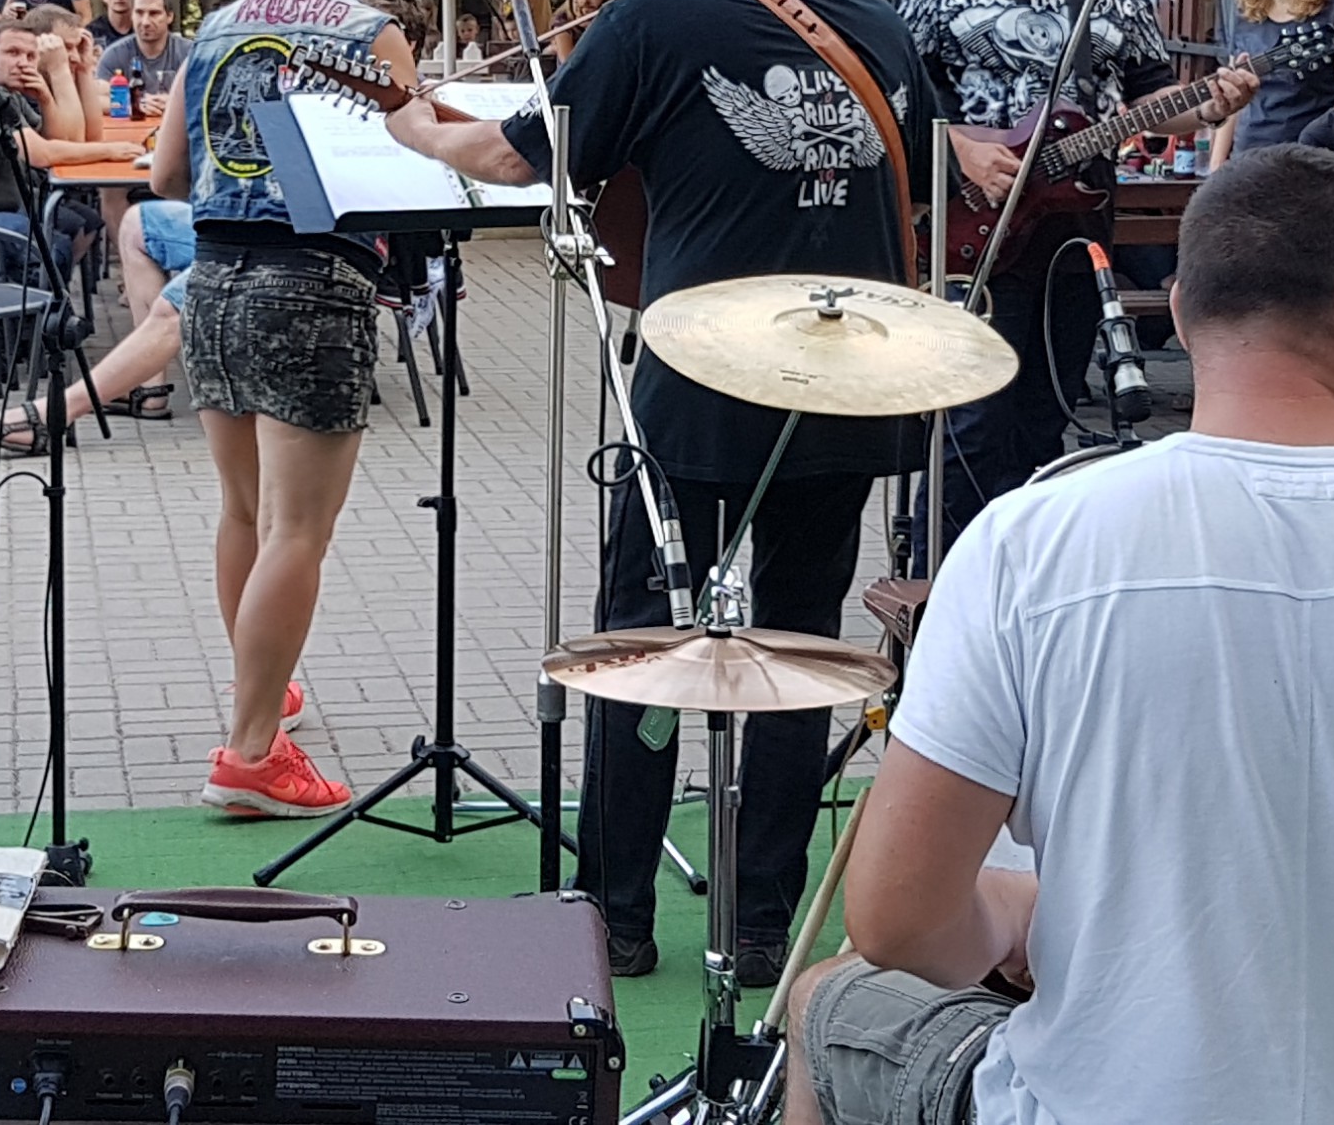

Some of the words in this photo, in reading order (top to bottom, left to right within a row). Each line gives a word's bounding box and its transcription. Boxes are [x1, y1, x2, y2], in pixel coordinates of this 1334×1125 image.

[798, 70, 847, 96] LIVE
[802, 99, 854, 127] RIDE
[802, 144, 852, 172] RIDE
[797, 178, 850, 208] LIVE
